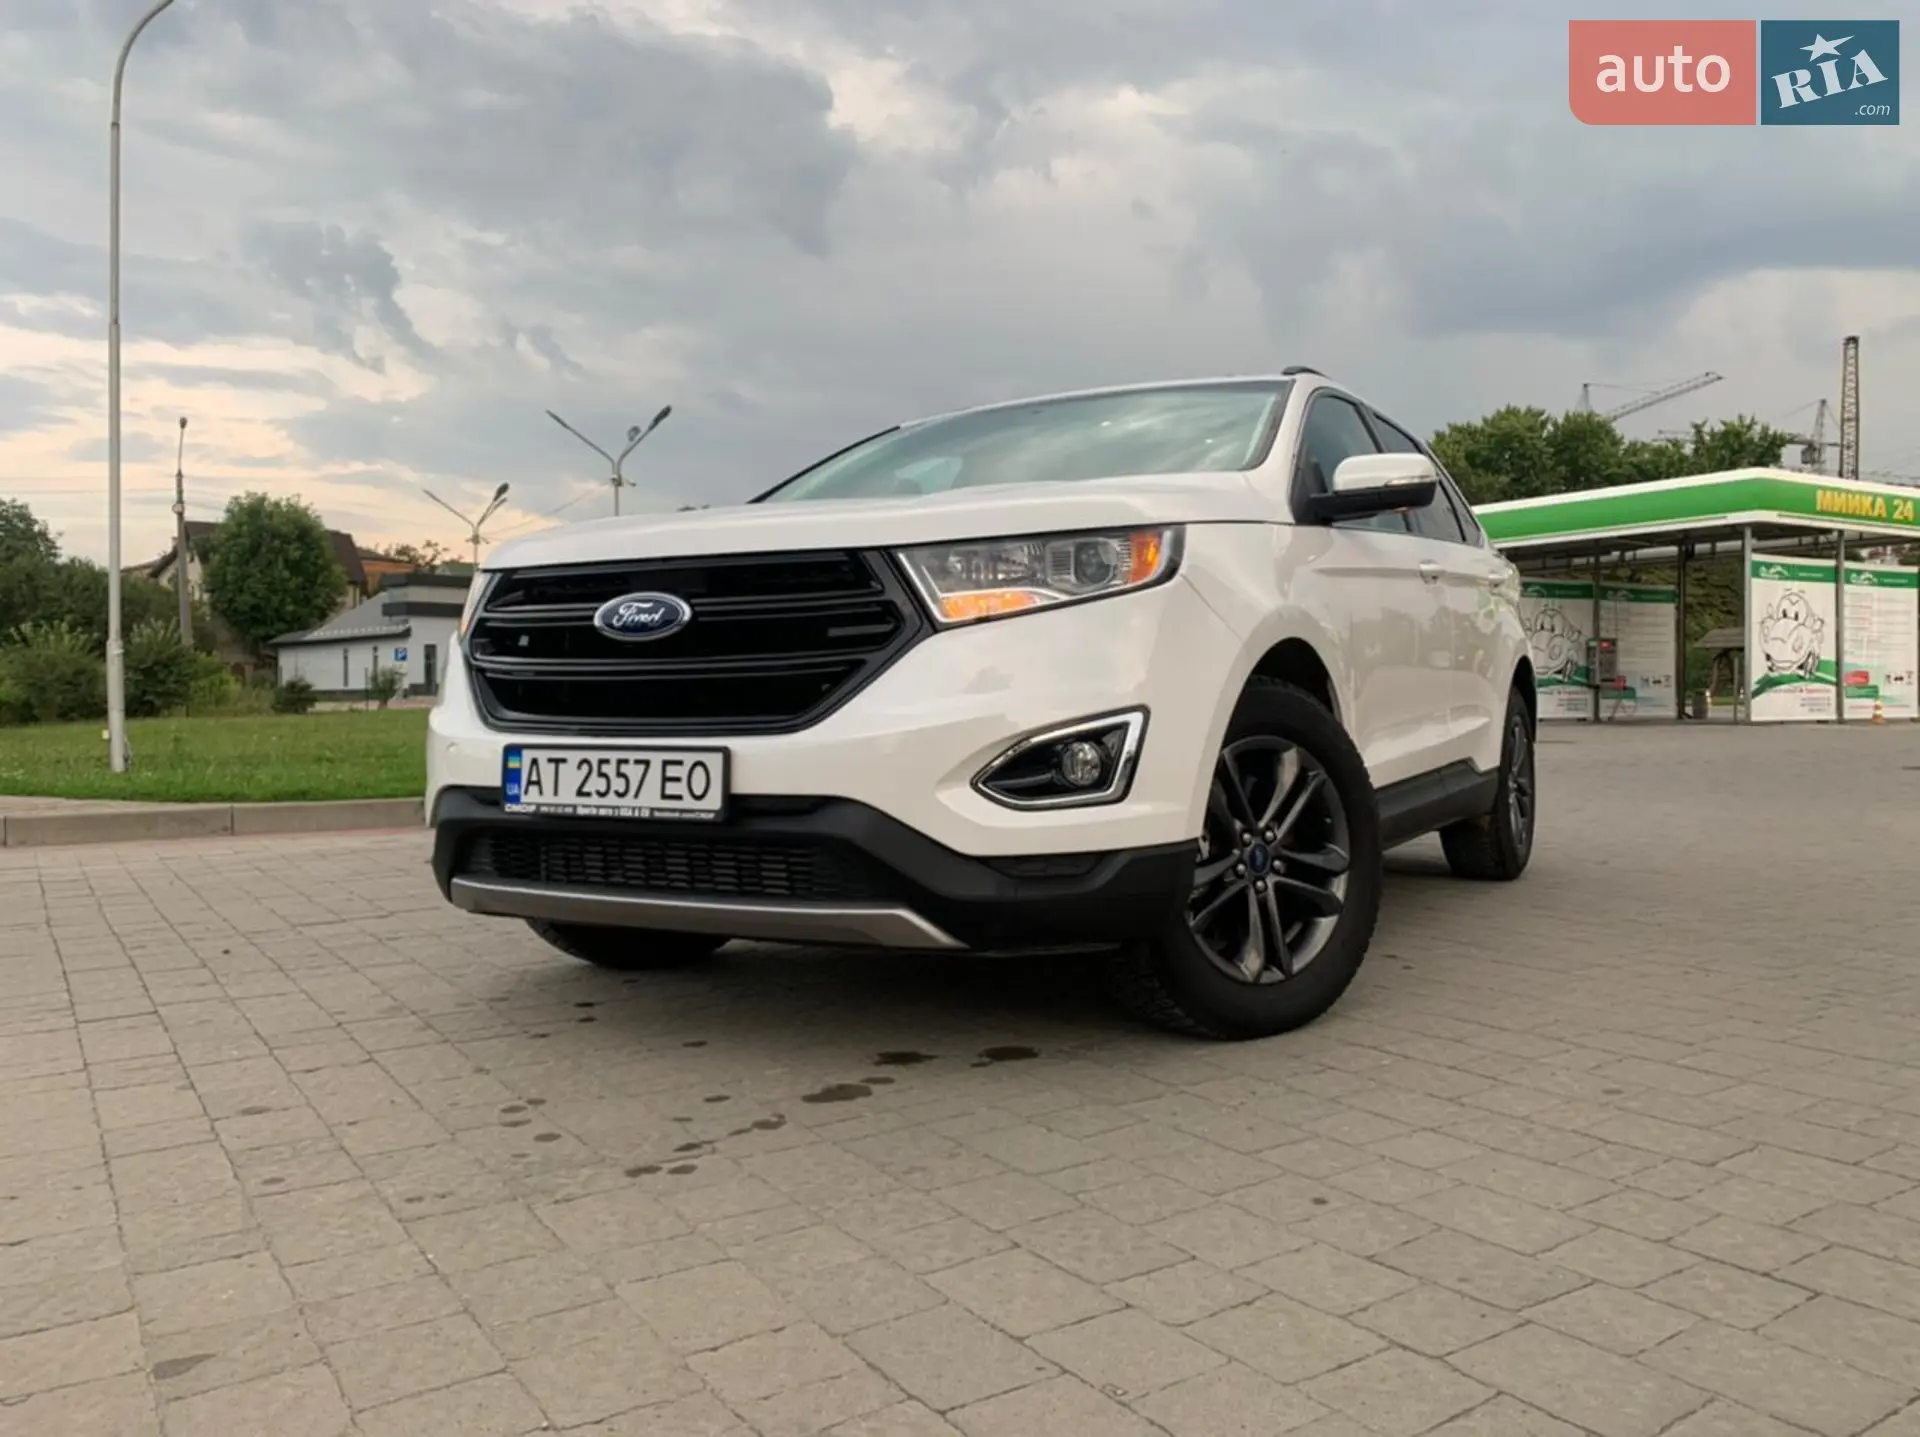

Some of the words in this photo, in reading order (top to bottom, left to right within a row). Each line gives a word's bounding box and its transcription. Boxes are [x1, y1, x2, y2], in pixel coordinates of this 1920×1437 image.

[1892, 498, 1914, 521] 24
[612, 601, 666, 627] Ford
[506, 783, 520, 796] UA
[524, 757, 568, 797] AT
[575, 758, 651, 799] 2557
[660, 759, 711, 802] EO
